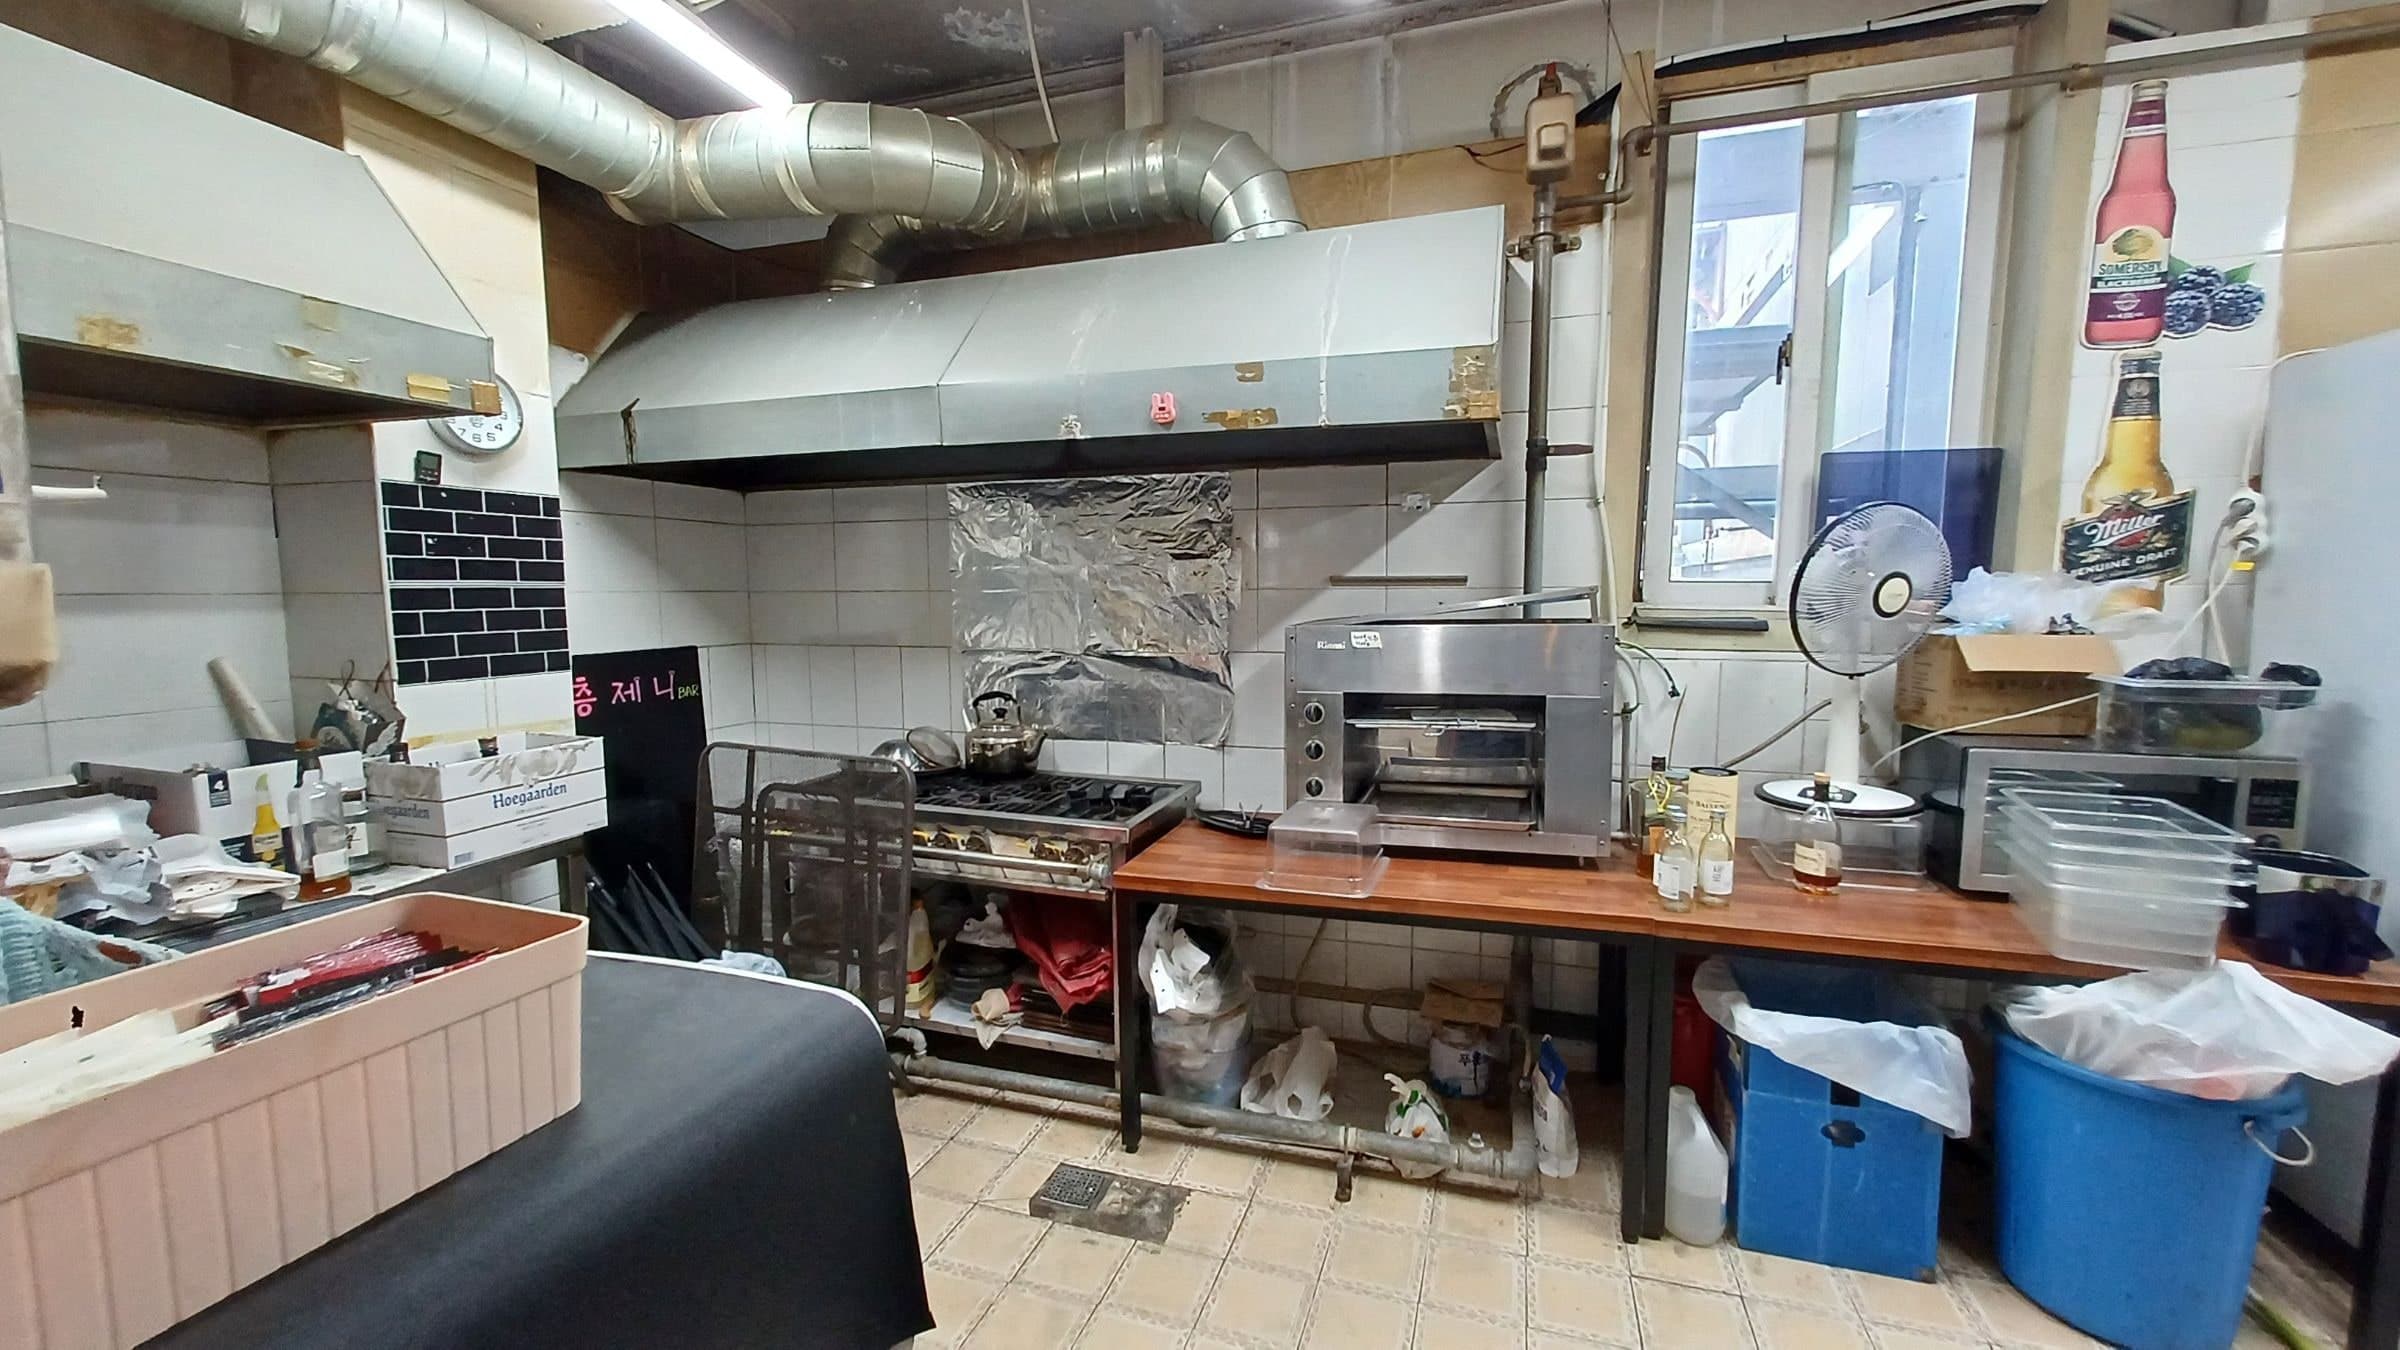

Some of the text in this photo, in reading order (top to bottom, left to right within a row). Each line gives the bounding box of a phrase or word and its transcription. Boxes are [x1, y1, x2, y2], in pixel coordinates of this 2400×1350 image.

[2098, 261, 2161, 275] SOMERSBY
[2084, 514, 2165, 543] Miller
[2135, 546, 2178, 565] DRAFT
[677, 684, 700, 700] BAR
[492, 782, 568, 809] Hoegaarden
